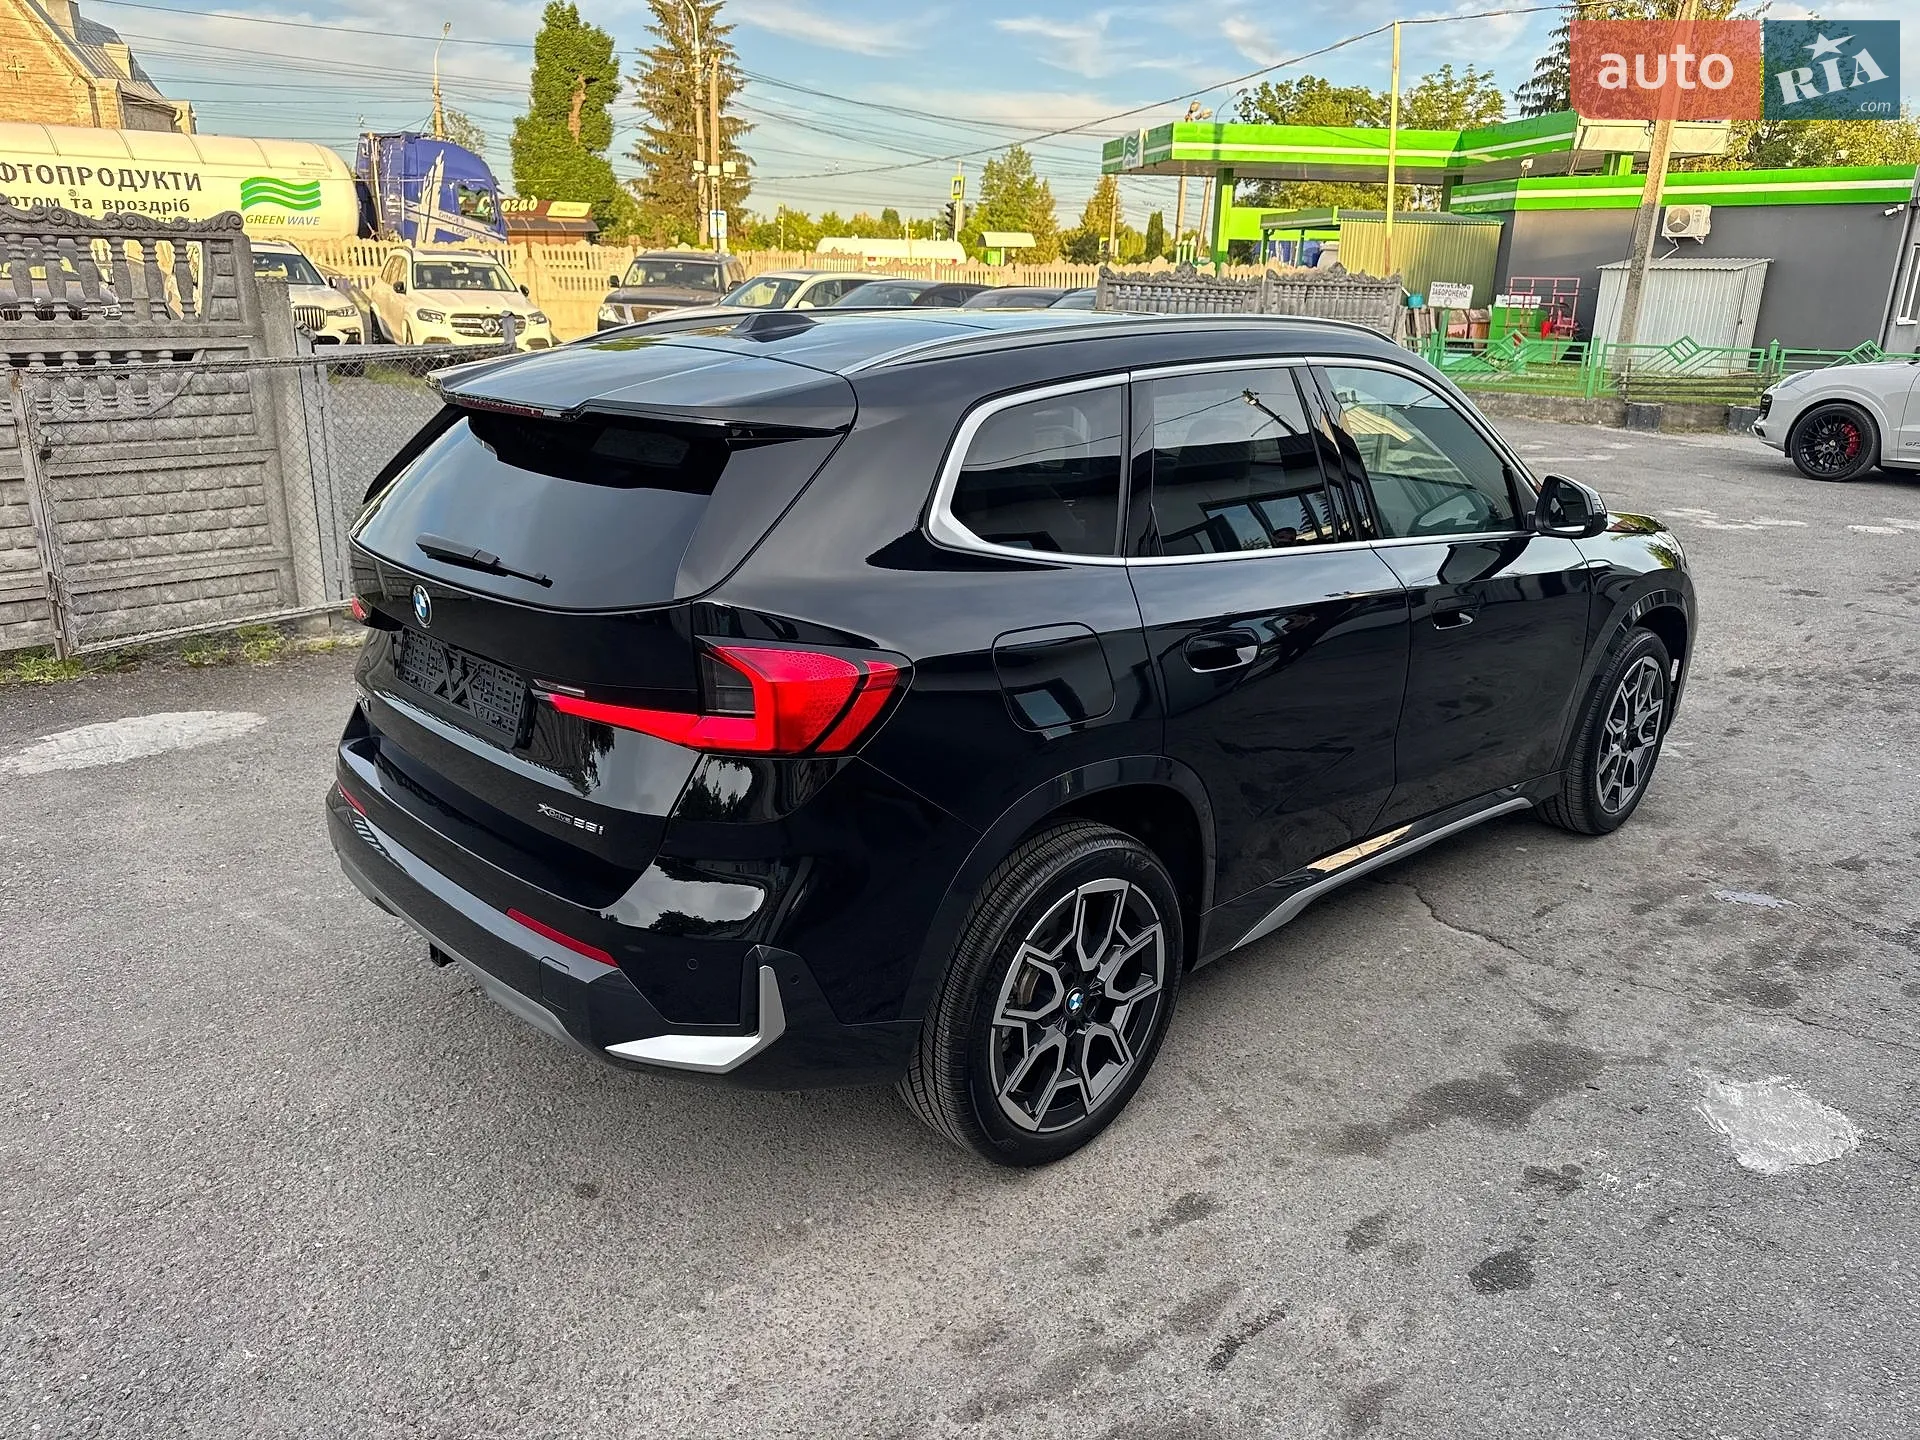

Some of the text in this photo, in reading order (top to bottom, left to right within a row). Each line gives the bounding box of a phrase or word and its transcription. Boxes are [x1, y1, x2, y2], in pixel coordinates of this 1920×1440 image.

[71, 198, 93, 210] та
[102, 198, 190, 215] вроздріб
[245, 214, 320, 226] GREEN WAVE
